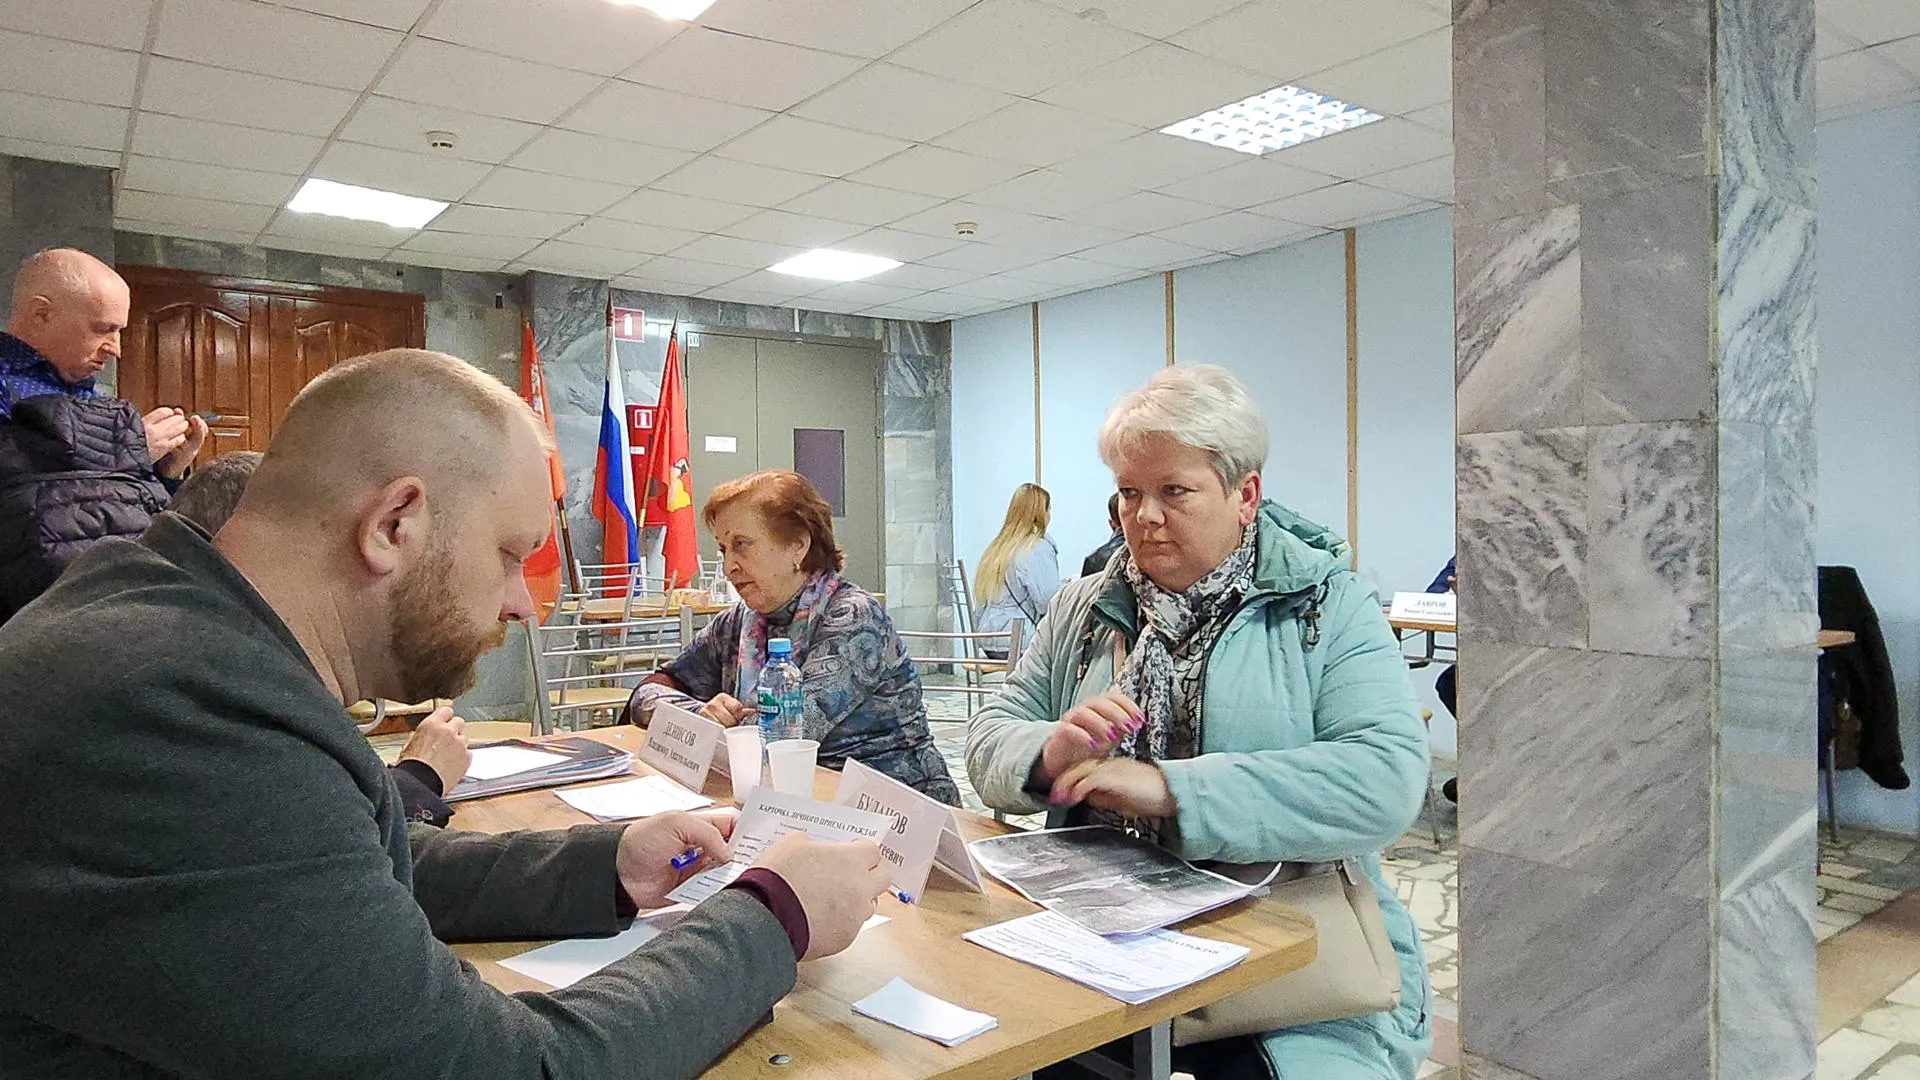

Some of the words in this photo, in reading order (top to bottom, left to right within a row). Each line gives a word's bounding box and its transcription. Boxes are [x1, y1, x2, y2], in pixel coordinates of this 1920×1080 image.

[662, 721, 697, 747] ДЕНИСОВ
[758, 802, 790, 817] КАРТОЧКА
[878, 843, 905, 868] геевич
